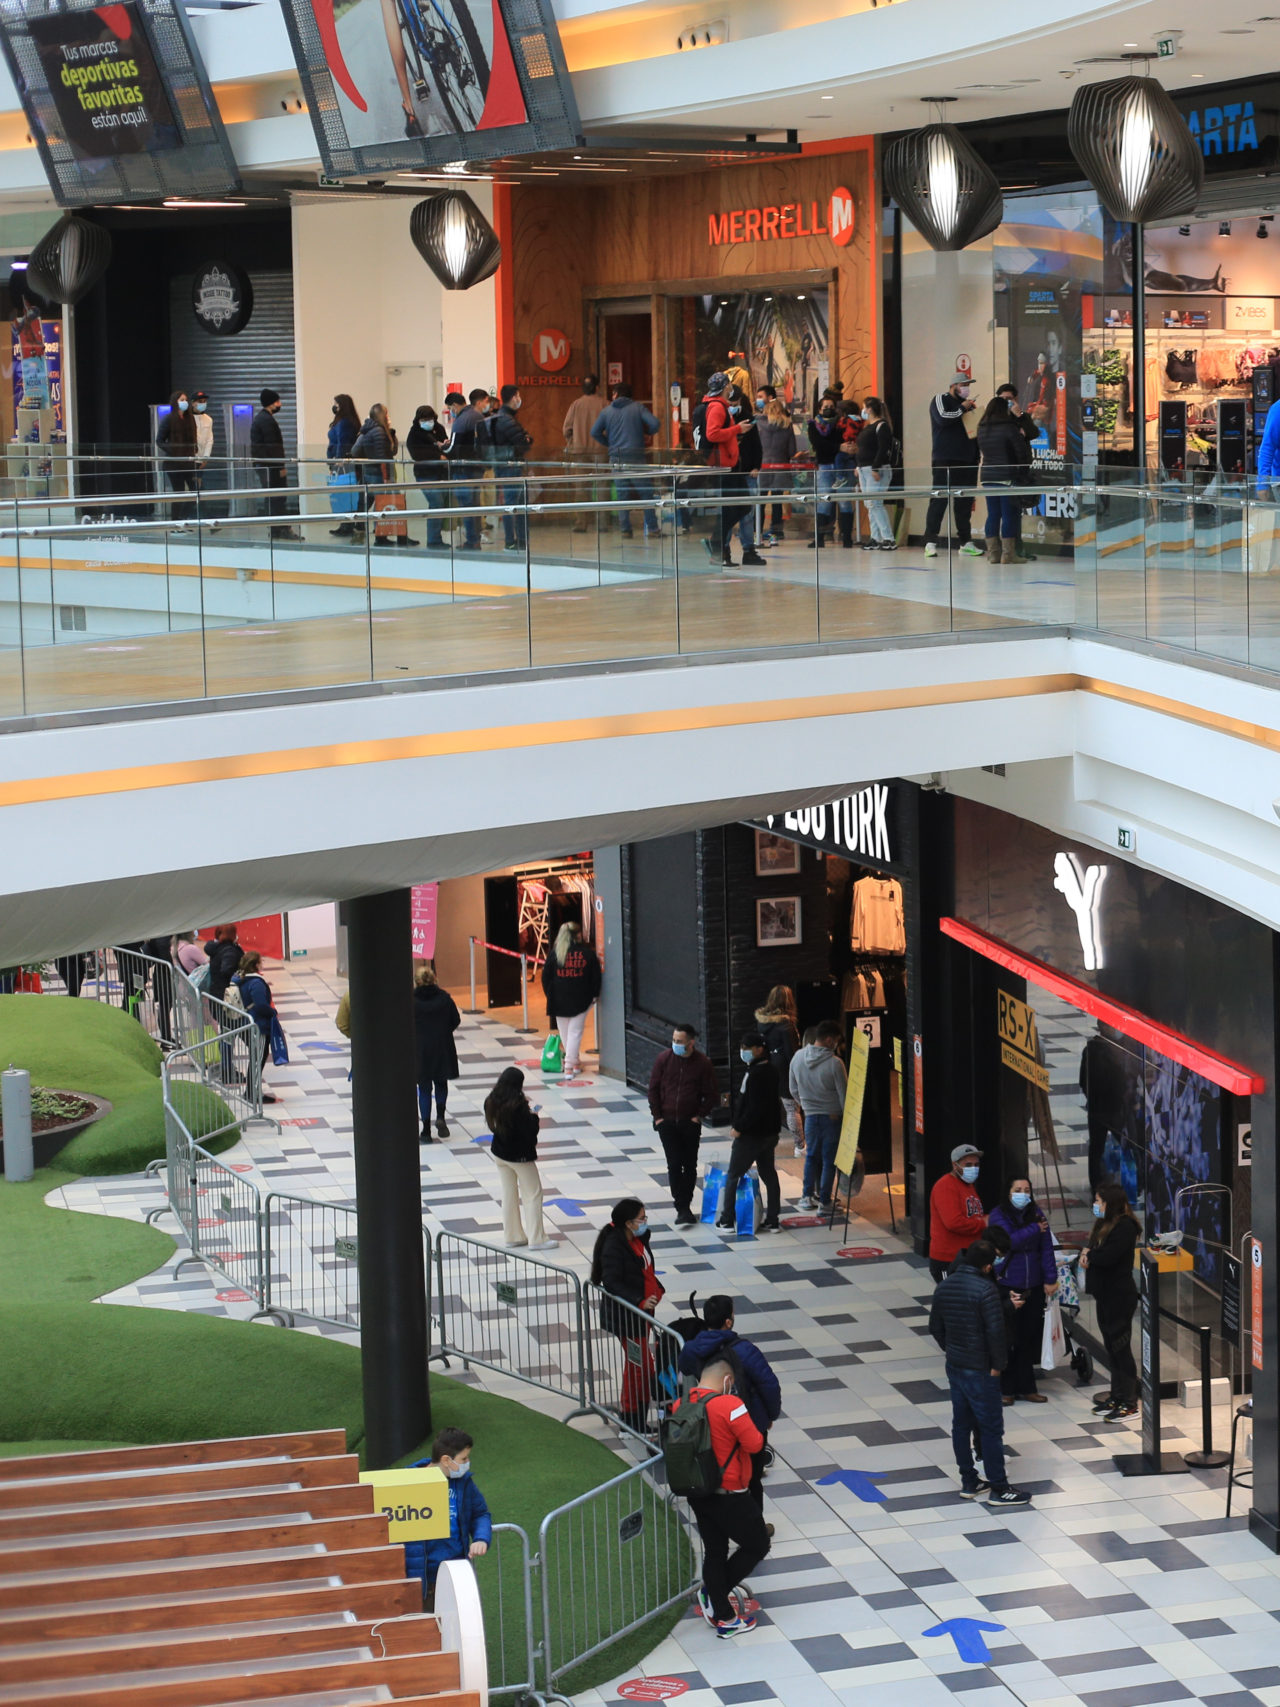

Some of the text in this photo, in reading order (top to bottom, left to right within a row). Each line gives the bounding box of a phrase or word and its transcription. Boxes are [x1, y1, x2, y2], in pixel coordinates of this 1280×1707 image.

[60, 41, 118, 60] Tus marcas
[61, 57, 138, 89] deportivas
[77, 83, 143, 110] favoritas
[91, 106, 148, 128] están aquí!
[1180, 101, 1259, 156] ARTA
[708, 202, 827, 246] MERRELL
[518, 375, 583, 387] MERRELL
[832, 783, 891, 862] YORK
[1000, 993, 1034, 1052] RS-X
